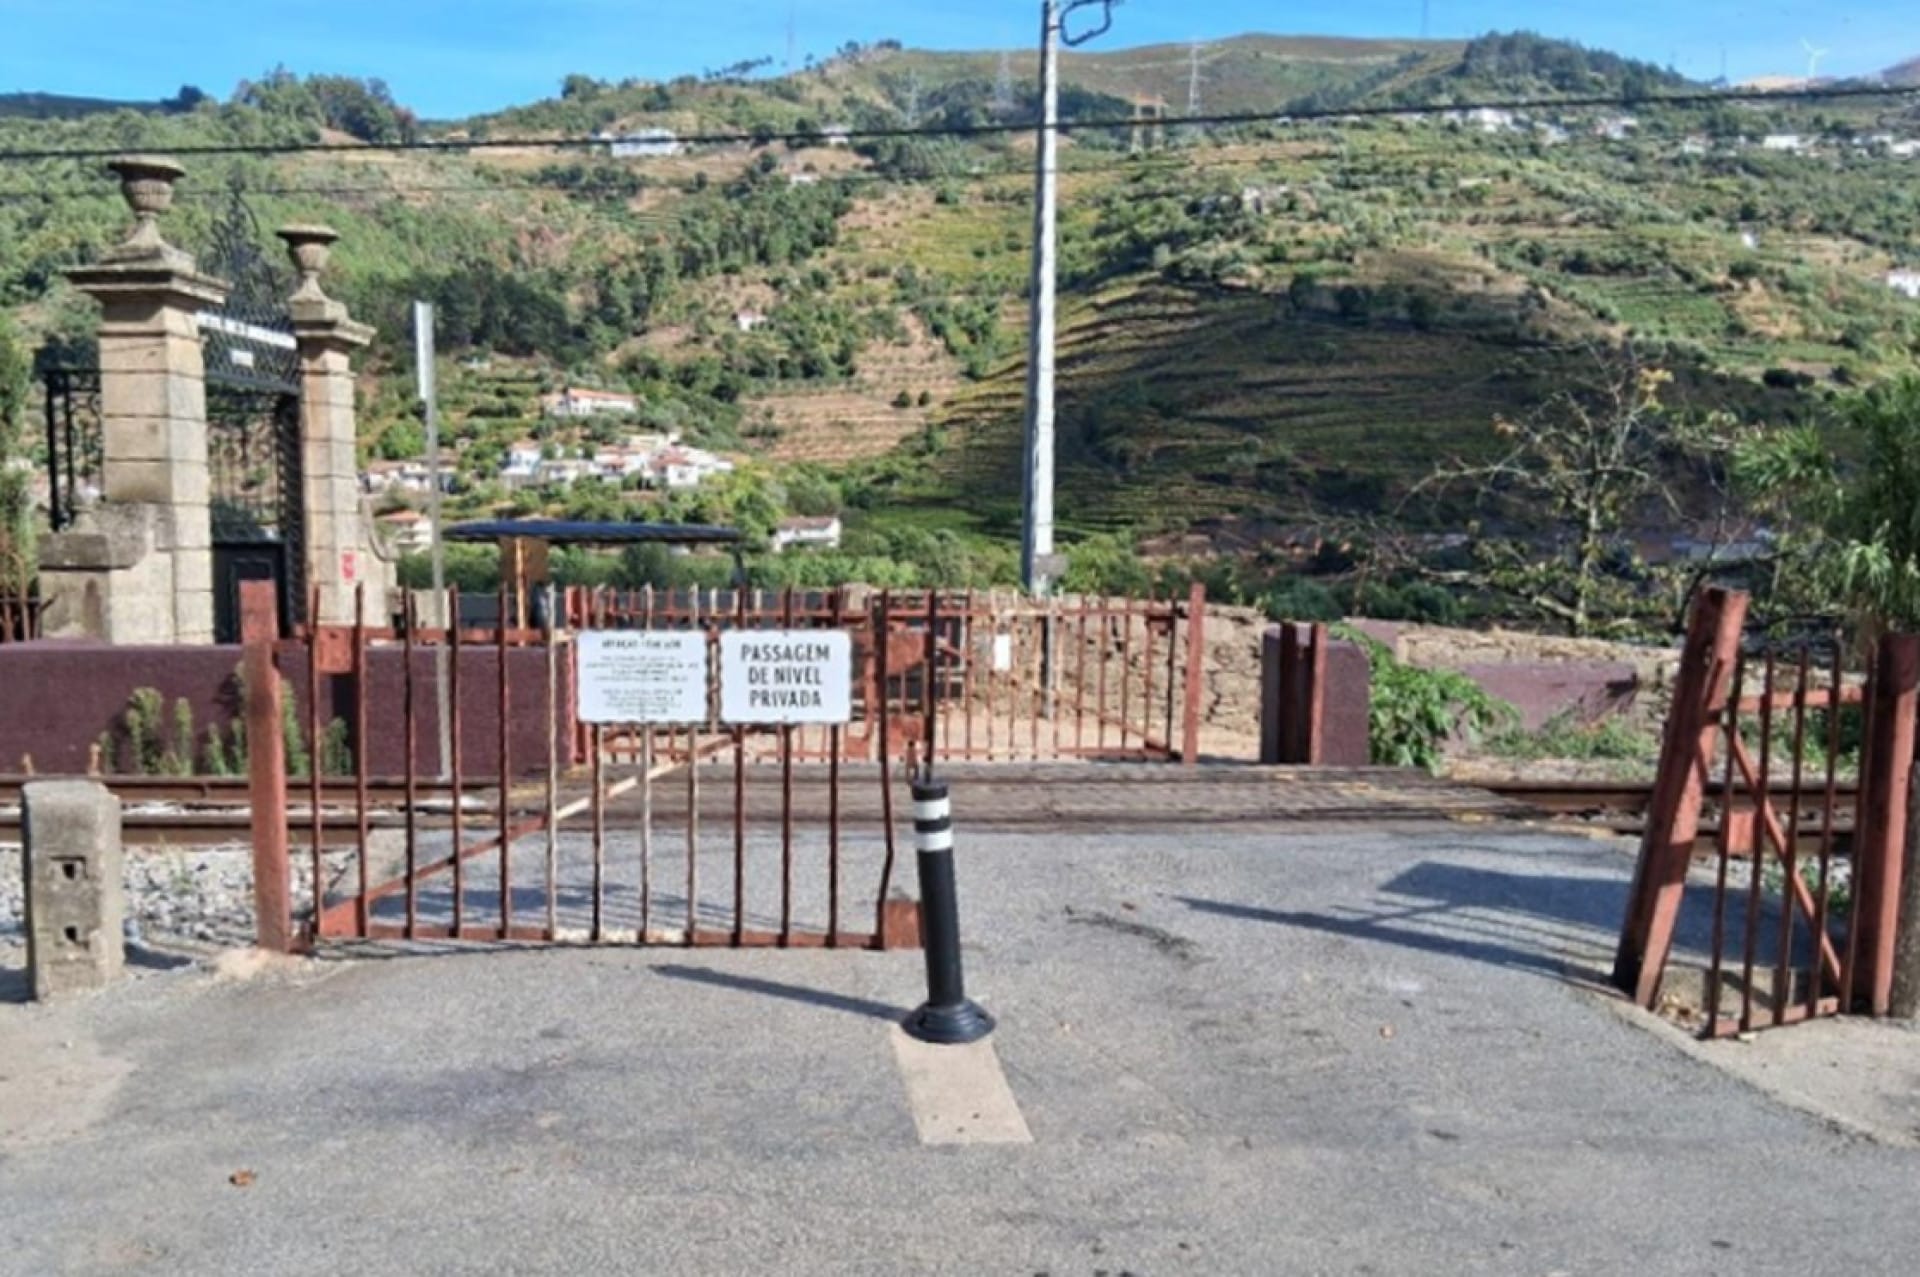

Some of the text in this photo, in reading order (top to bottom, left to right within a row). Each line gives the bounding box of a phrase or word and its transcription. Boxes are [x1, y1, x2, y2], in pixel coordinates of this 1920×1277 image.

[741, 643, 830, 662] PASSAGEM
[748, 666, 769, 684] DE
[749, 690, 821, 708] PRIVADA
